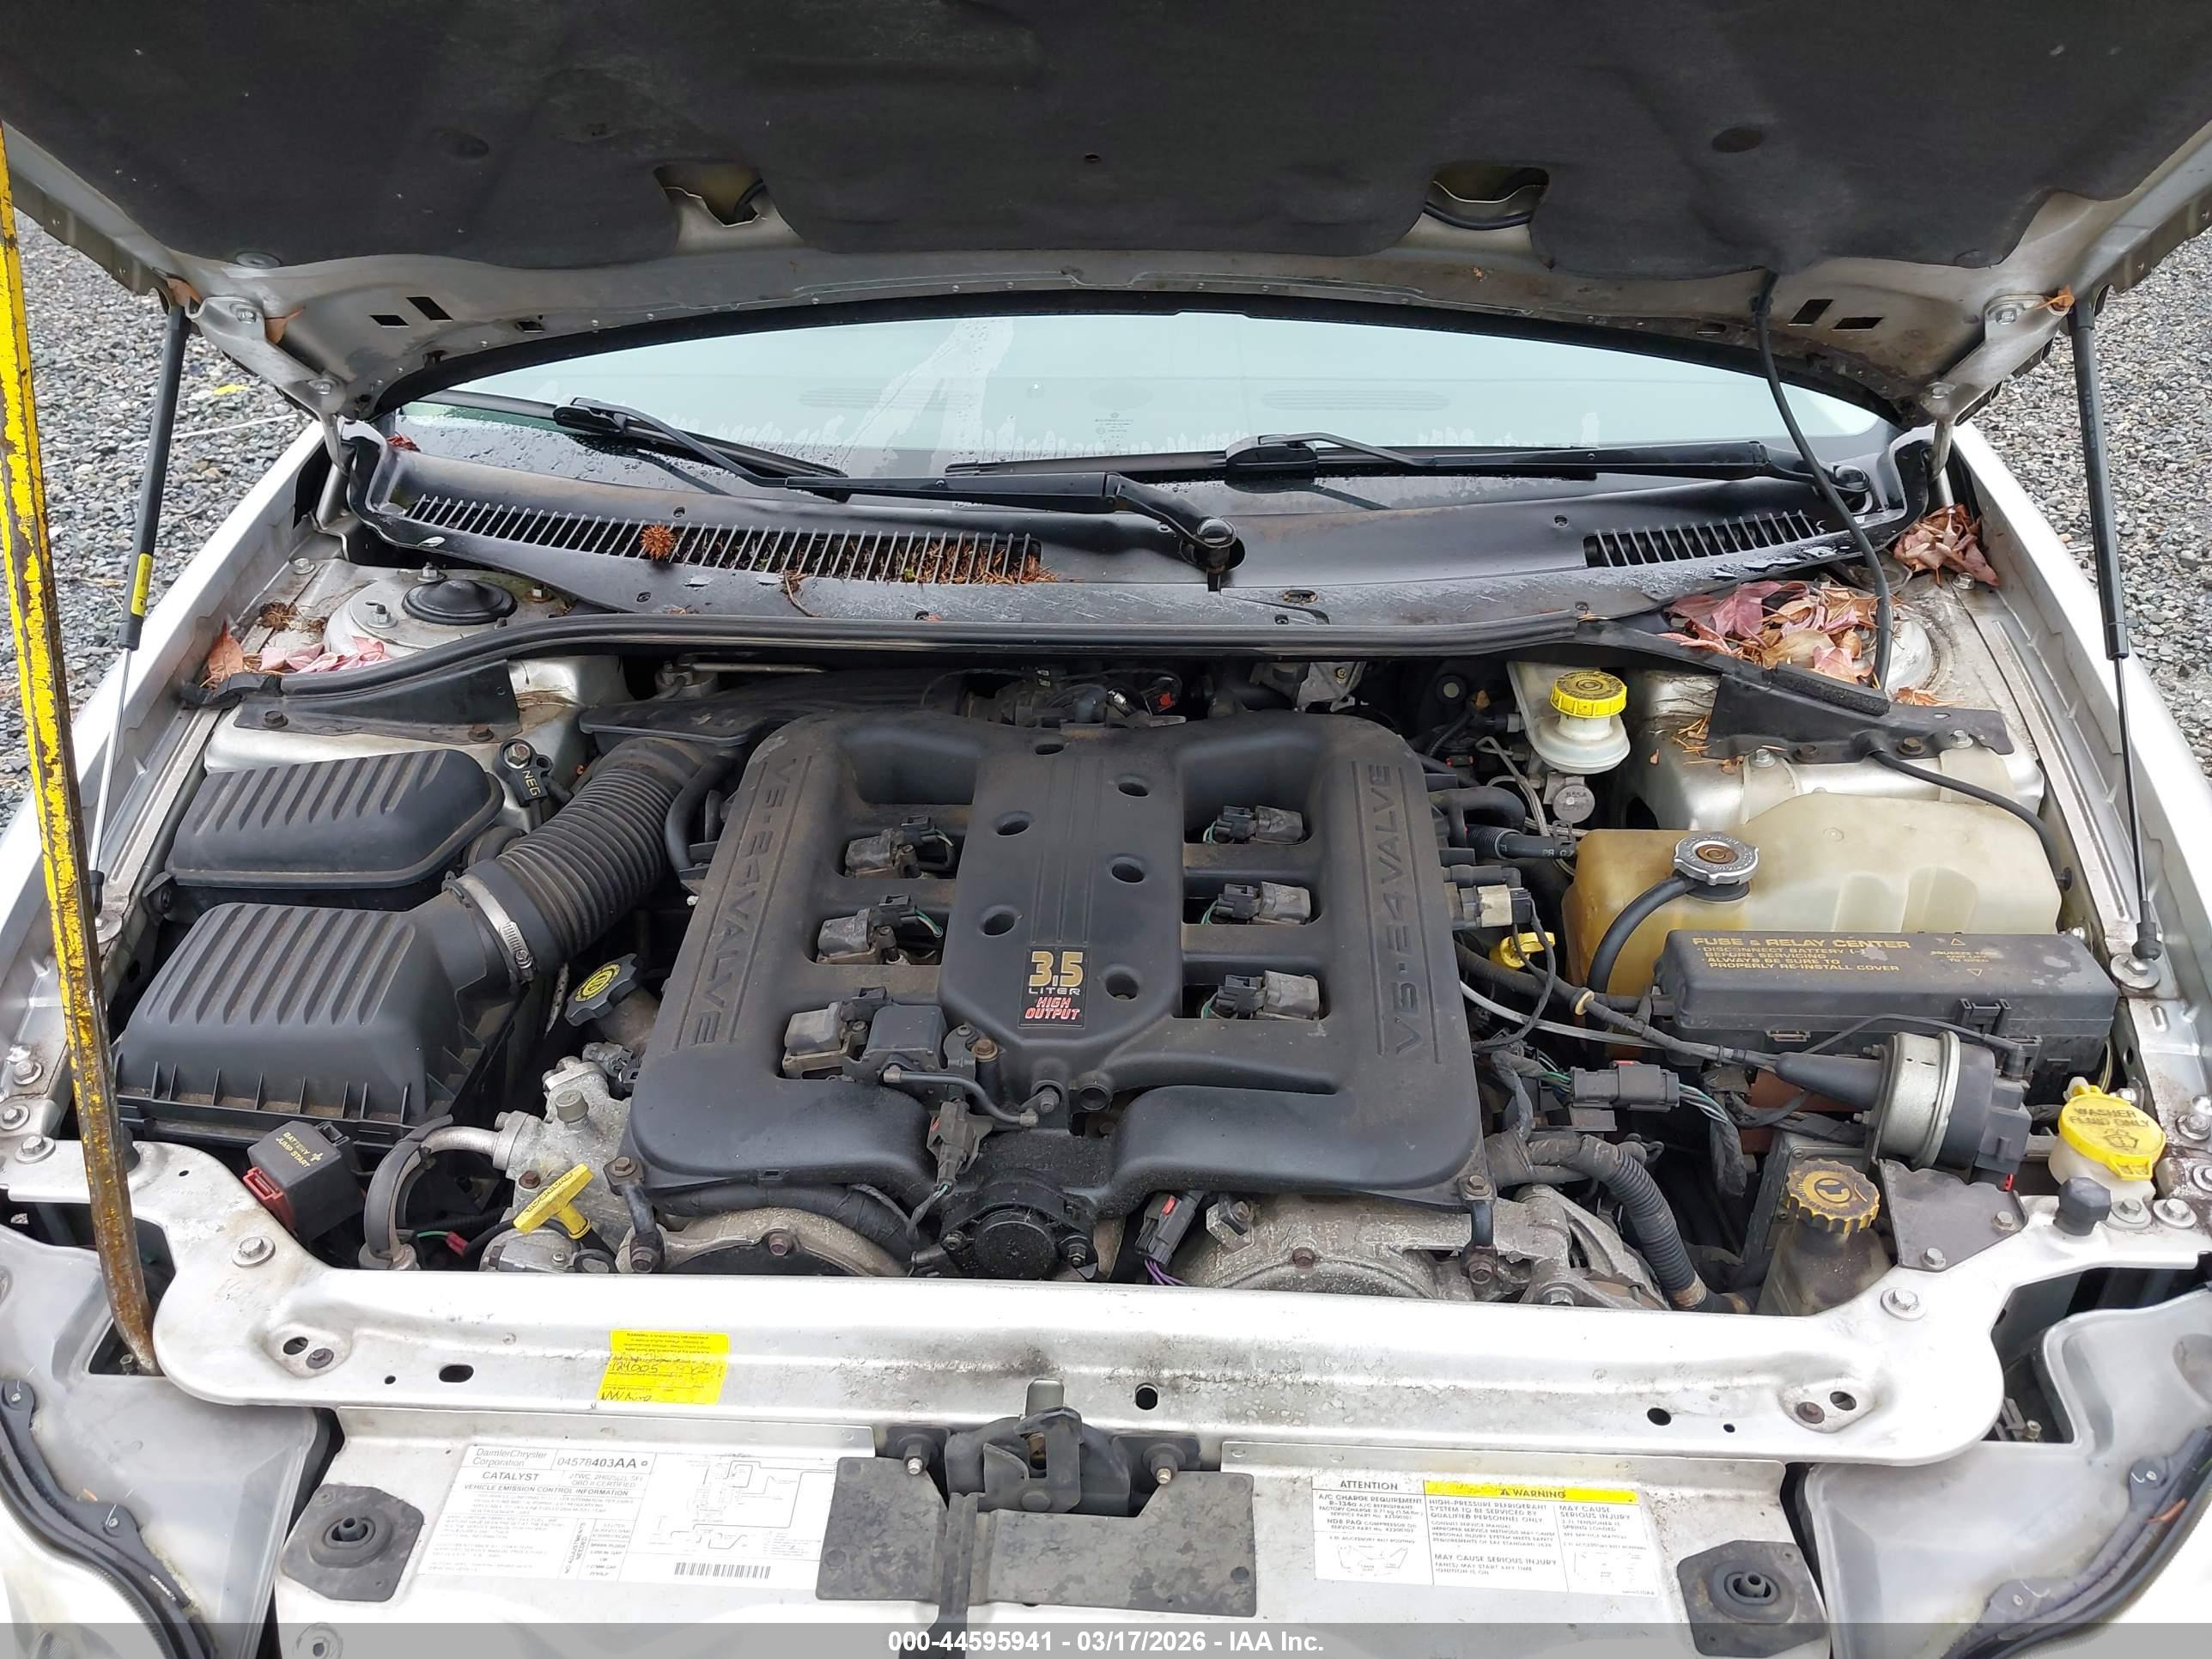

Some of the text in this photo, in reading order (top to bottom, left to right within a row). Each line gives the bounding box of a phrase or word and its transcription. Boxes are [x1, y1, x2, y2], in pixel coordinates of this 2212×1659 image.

[522, 770, 541, 797] NEG
[1765, 939, 1826, 947] RELAY
[1832, 939, 1911, 949] CENTER
[1029, 951, 1083, 987] 3.5
[1036, 997, 1072, 1008] HIGH
[1025, 1008, 1080, 1020] OUTPUT
[2074, 1108, 2136, 1118] WASHER
[2069, 1115, 2149, 1127] FLUID ONLY
[283, 1132, 311, 1155] BATTERY
[276, 1137, 311, 1168] JUMP START
[476, 1448, 548, 1460] DaimlerChrysler
[472, 1456, 525, 1468] Corporation
[557, 1457, 636, 1468] 04578403AA
[483, 1471, 540, 1480] CATALYST
[1340, 1480, 1398, 1490] ATTENTION
[575, 1488, 629, 1497] INFORMATION
[1512, 1489, 1566, 1498] WARNING
[1429, 1499, 1491, 1508] HIGH-PRESSURE
[1487, 1556, 1523, 1565] SERIOUS
